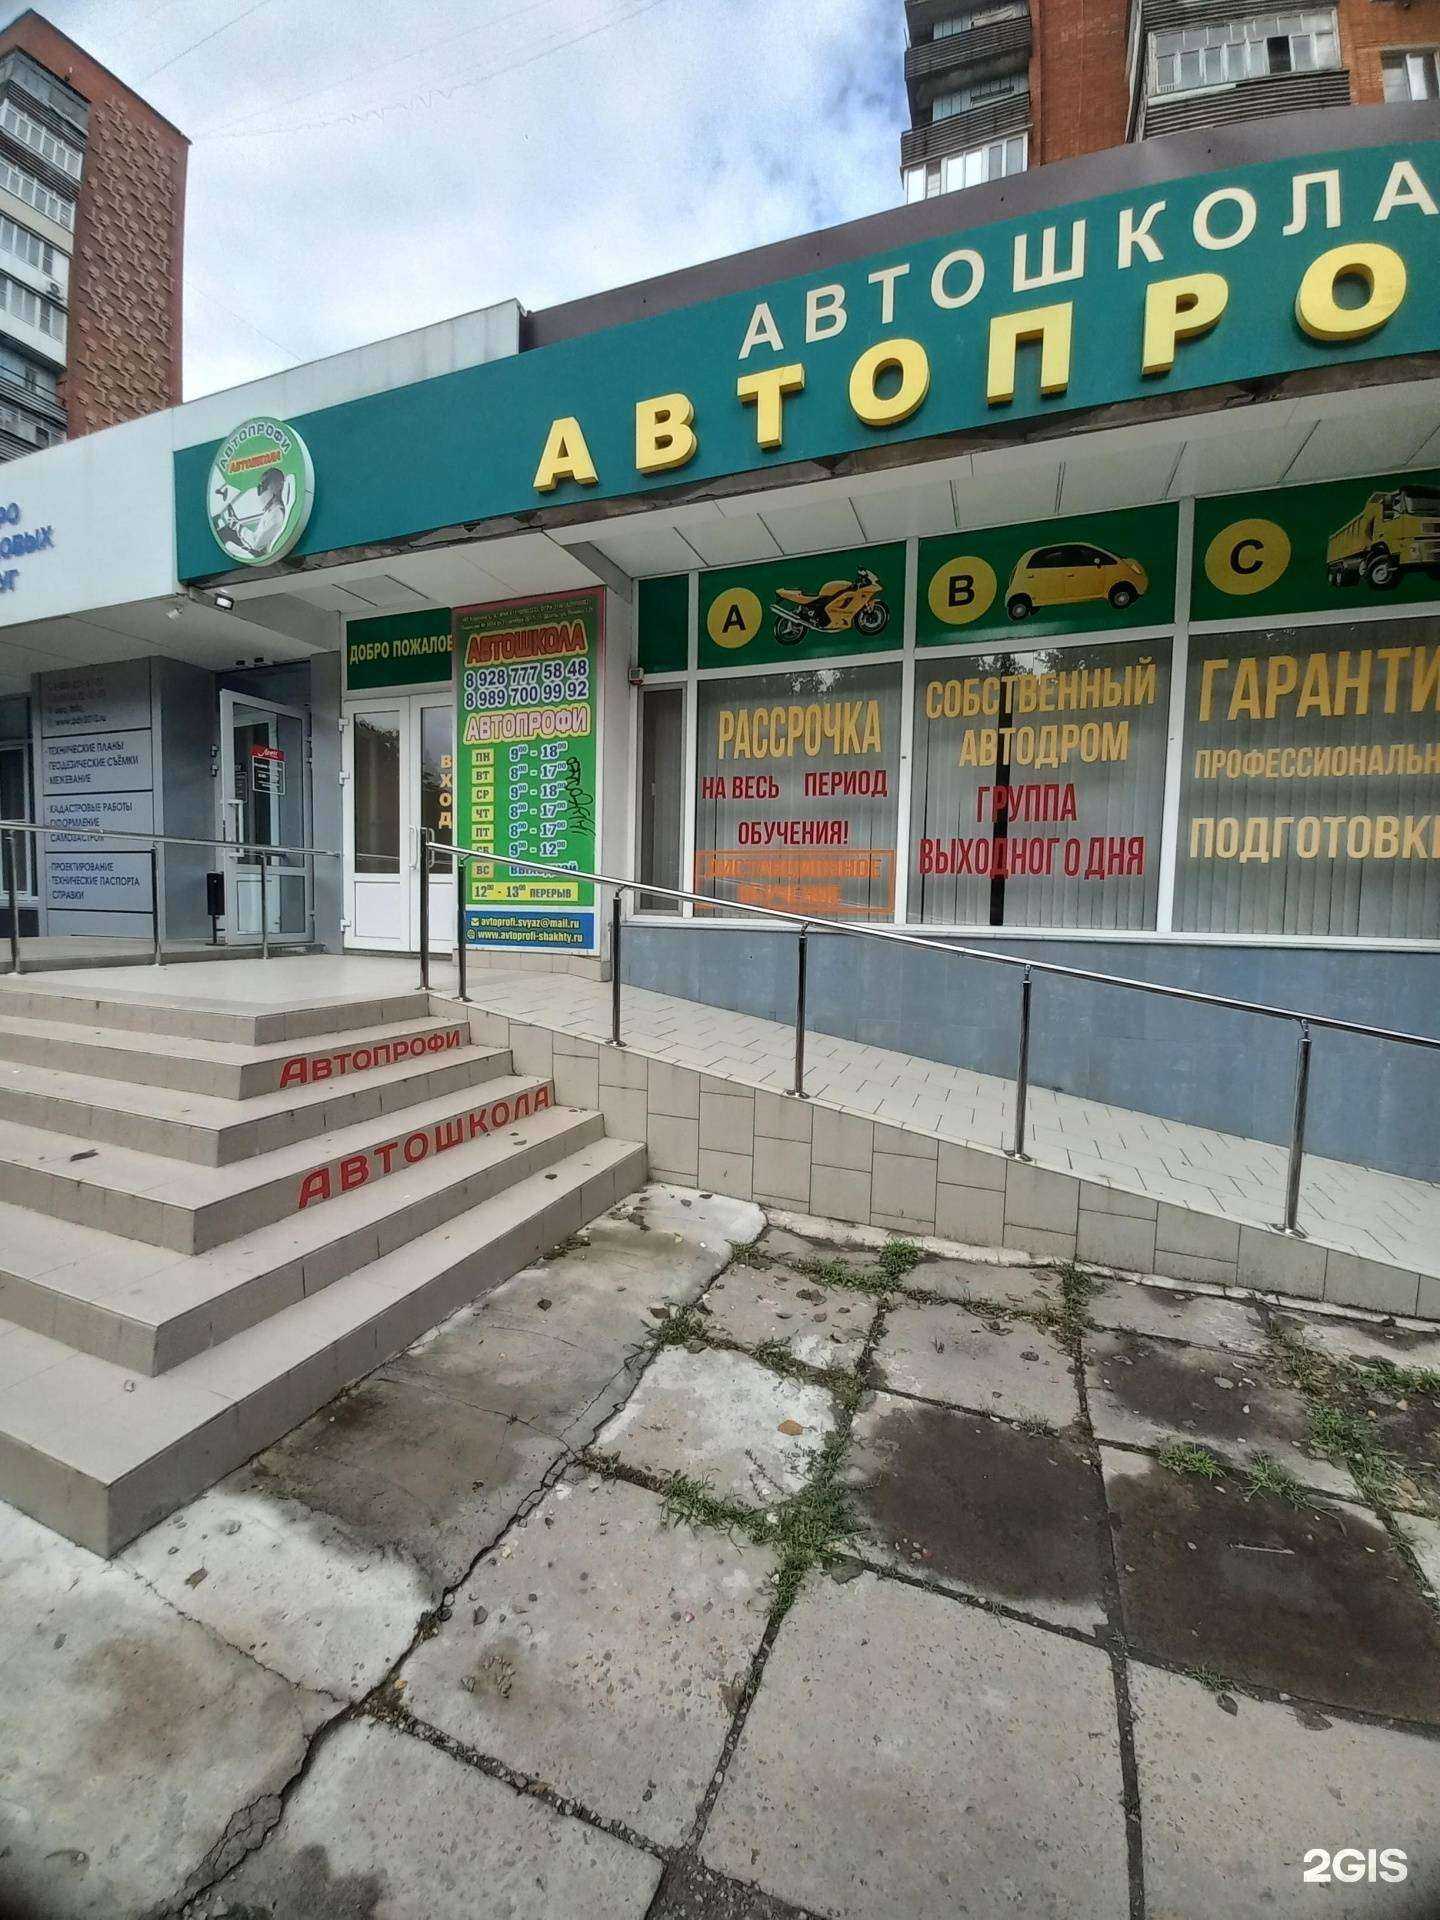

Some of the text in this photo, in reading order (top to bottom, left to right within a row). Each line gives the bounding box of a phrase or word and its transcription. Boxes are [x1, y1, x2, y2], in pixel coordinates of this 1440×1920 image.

[738, 160, 1440, 360] АВТОШКОЛА
[533, 241, 1407, 492] АВТОПРО
[219, 422, 292, 470] АВТОПРОФИ
[349, 641, 390, 665] ДОБРО
[466, 622, 587, 666] АВТОШКОЛА
[465, 658, 587, 688] 8 928 777 58 48
[1198, 645, 1440, 722] ГАРАНТИ
[465, 681, 587, 708] 8 989 700 99 92
[926, 656, 1157, 719] СОБСТВЕННЫЙ
[465, 706, 589, 742] АВТОПРОФИ
[717, 699, 882, 760] РАССРОЧКА
[48, 741, 124, 755] ТЕХНИЧЕСКИЕ ПЛАНЫ
[475, 752, 490, 762] ПН
[958, 721, 1130, 770] АВТОДРОМ
[1194, 743, 1440, 780] ПРОФЕССИОНАЛЬН
[49, 774, 91, 785] МЕЖЕВАНИЕ
[476, 770, 490, 781] ВТ
[702, 769, 888, 800] НА ВЕСЬ ПЕРИОД
[476, 789, 490, 799] СР
[976, 783, 1078, 823] ГРУППА
[49, 802, 133, 814] КАДАСТРОВЫЕ РАБОТЫ
[475, 808, 490, 818] ЧТ
[475, 827, 490, 837] ПТ
[738, 820, 849, 845] ОБУЧЕНИЯ!
[51, 862, 114, 872] ПРОЕКТИРОВАНИЕ
[476, 865, 490, 875] ВС
[1083, 836, 1145, 881] ДНЯ
[51, 875, 140, 887] ТЕХНИЧЕСКИЕ ПАСПОРТА
[529, 888, 572, 898] ПЕРЕРЫВ
[52, 890, 84, 900] СПРАВКИ
[477, 930, 583, 943] www.avtoprofi-shakhty.ru
[481, 918, 580, 929] avtoprofi.svyaz@mail.ru
[279, 1029, 461, 1088] АВТОПРОФИ
[298, 1085, 550, 1209] АВТОШКОЛА
